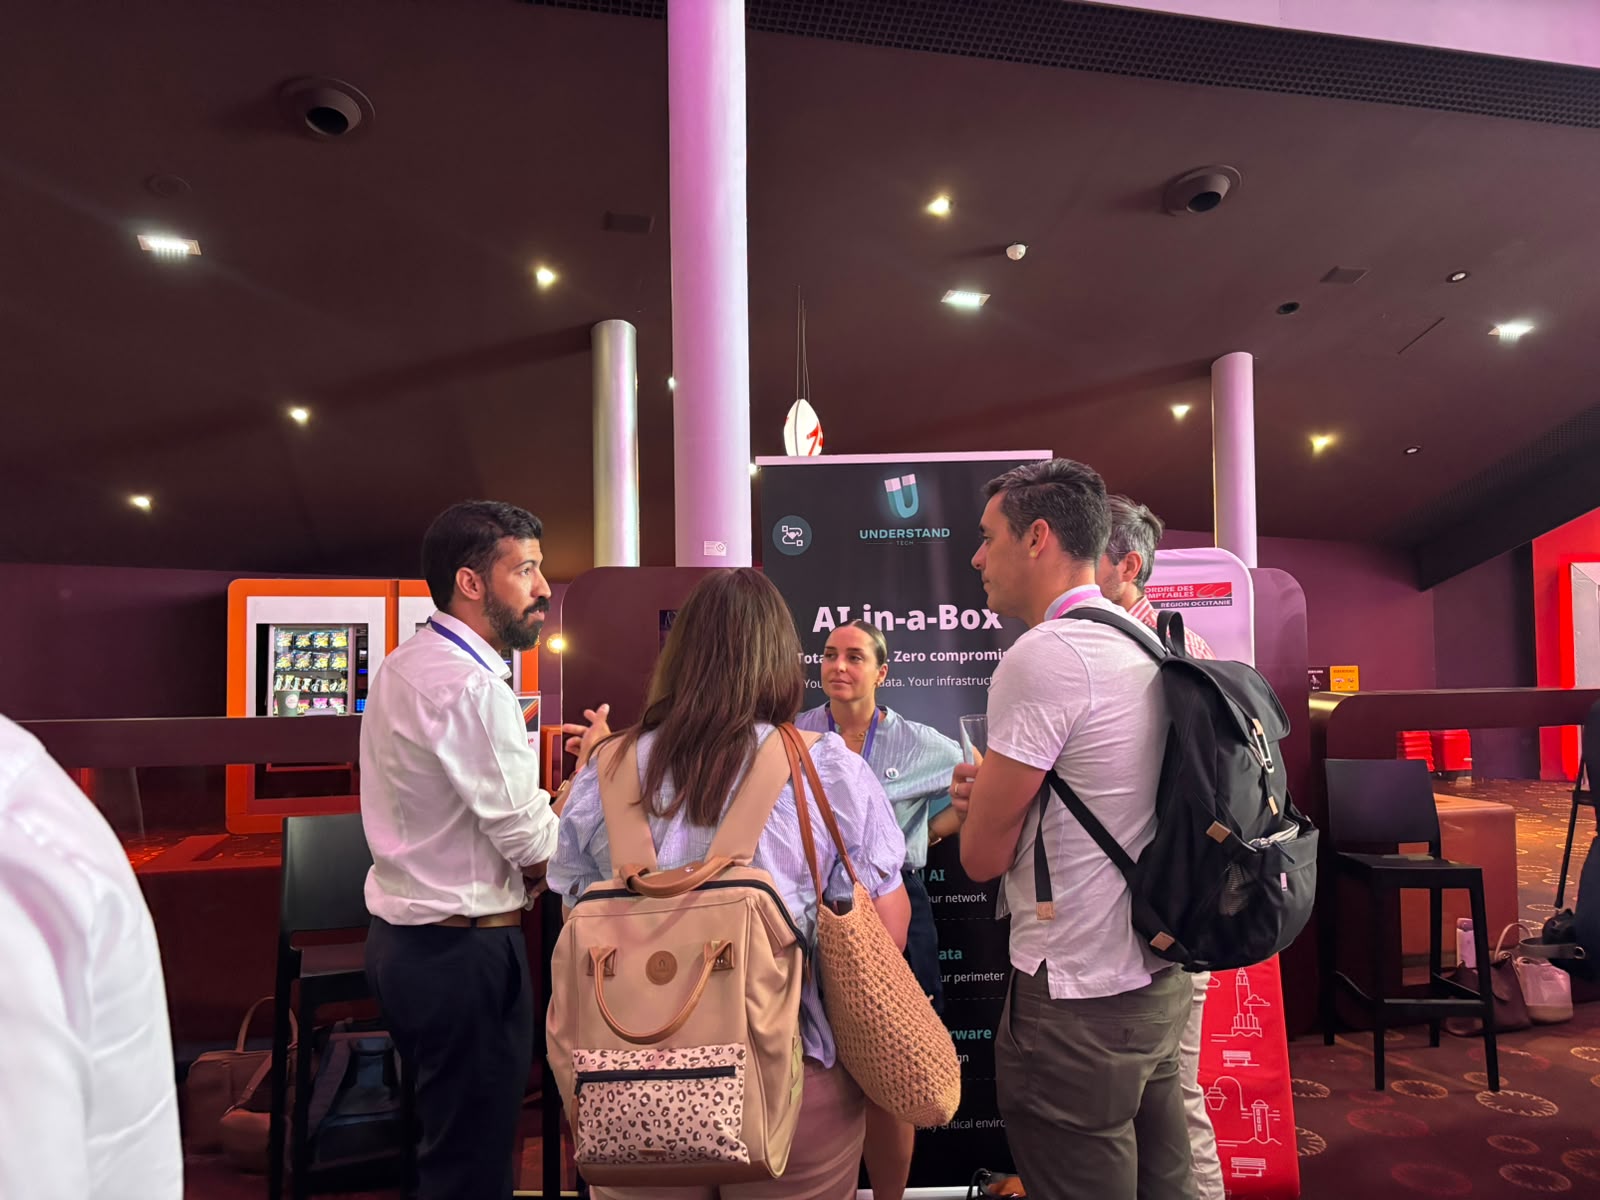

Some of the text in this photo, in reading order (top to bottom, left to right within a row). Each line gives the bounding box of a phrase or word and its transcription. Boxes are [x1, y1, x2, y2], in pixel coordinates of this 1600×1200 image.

[859, 528, 951, 539] UNDERSTAND
[1177, 584, 1194, 592] DES
[1146, 591, 1194, 599] MPTABLES
[1190, 599, 1231, 607] OCCITANIE
[812, 604, 1003, 633] AIin-a-Box
[797, 652, 824, 664] Tota
[893, 650, 926, 662] Zero
[804, 679, 823, 689] You
[908, 676, 933, 687] Your
[929, 869, 945, 881] AI
[928, 892, 987, 903] our network
[938, 949, 962, 960] ata
[954, 970, 1005, 984] perimeter
